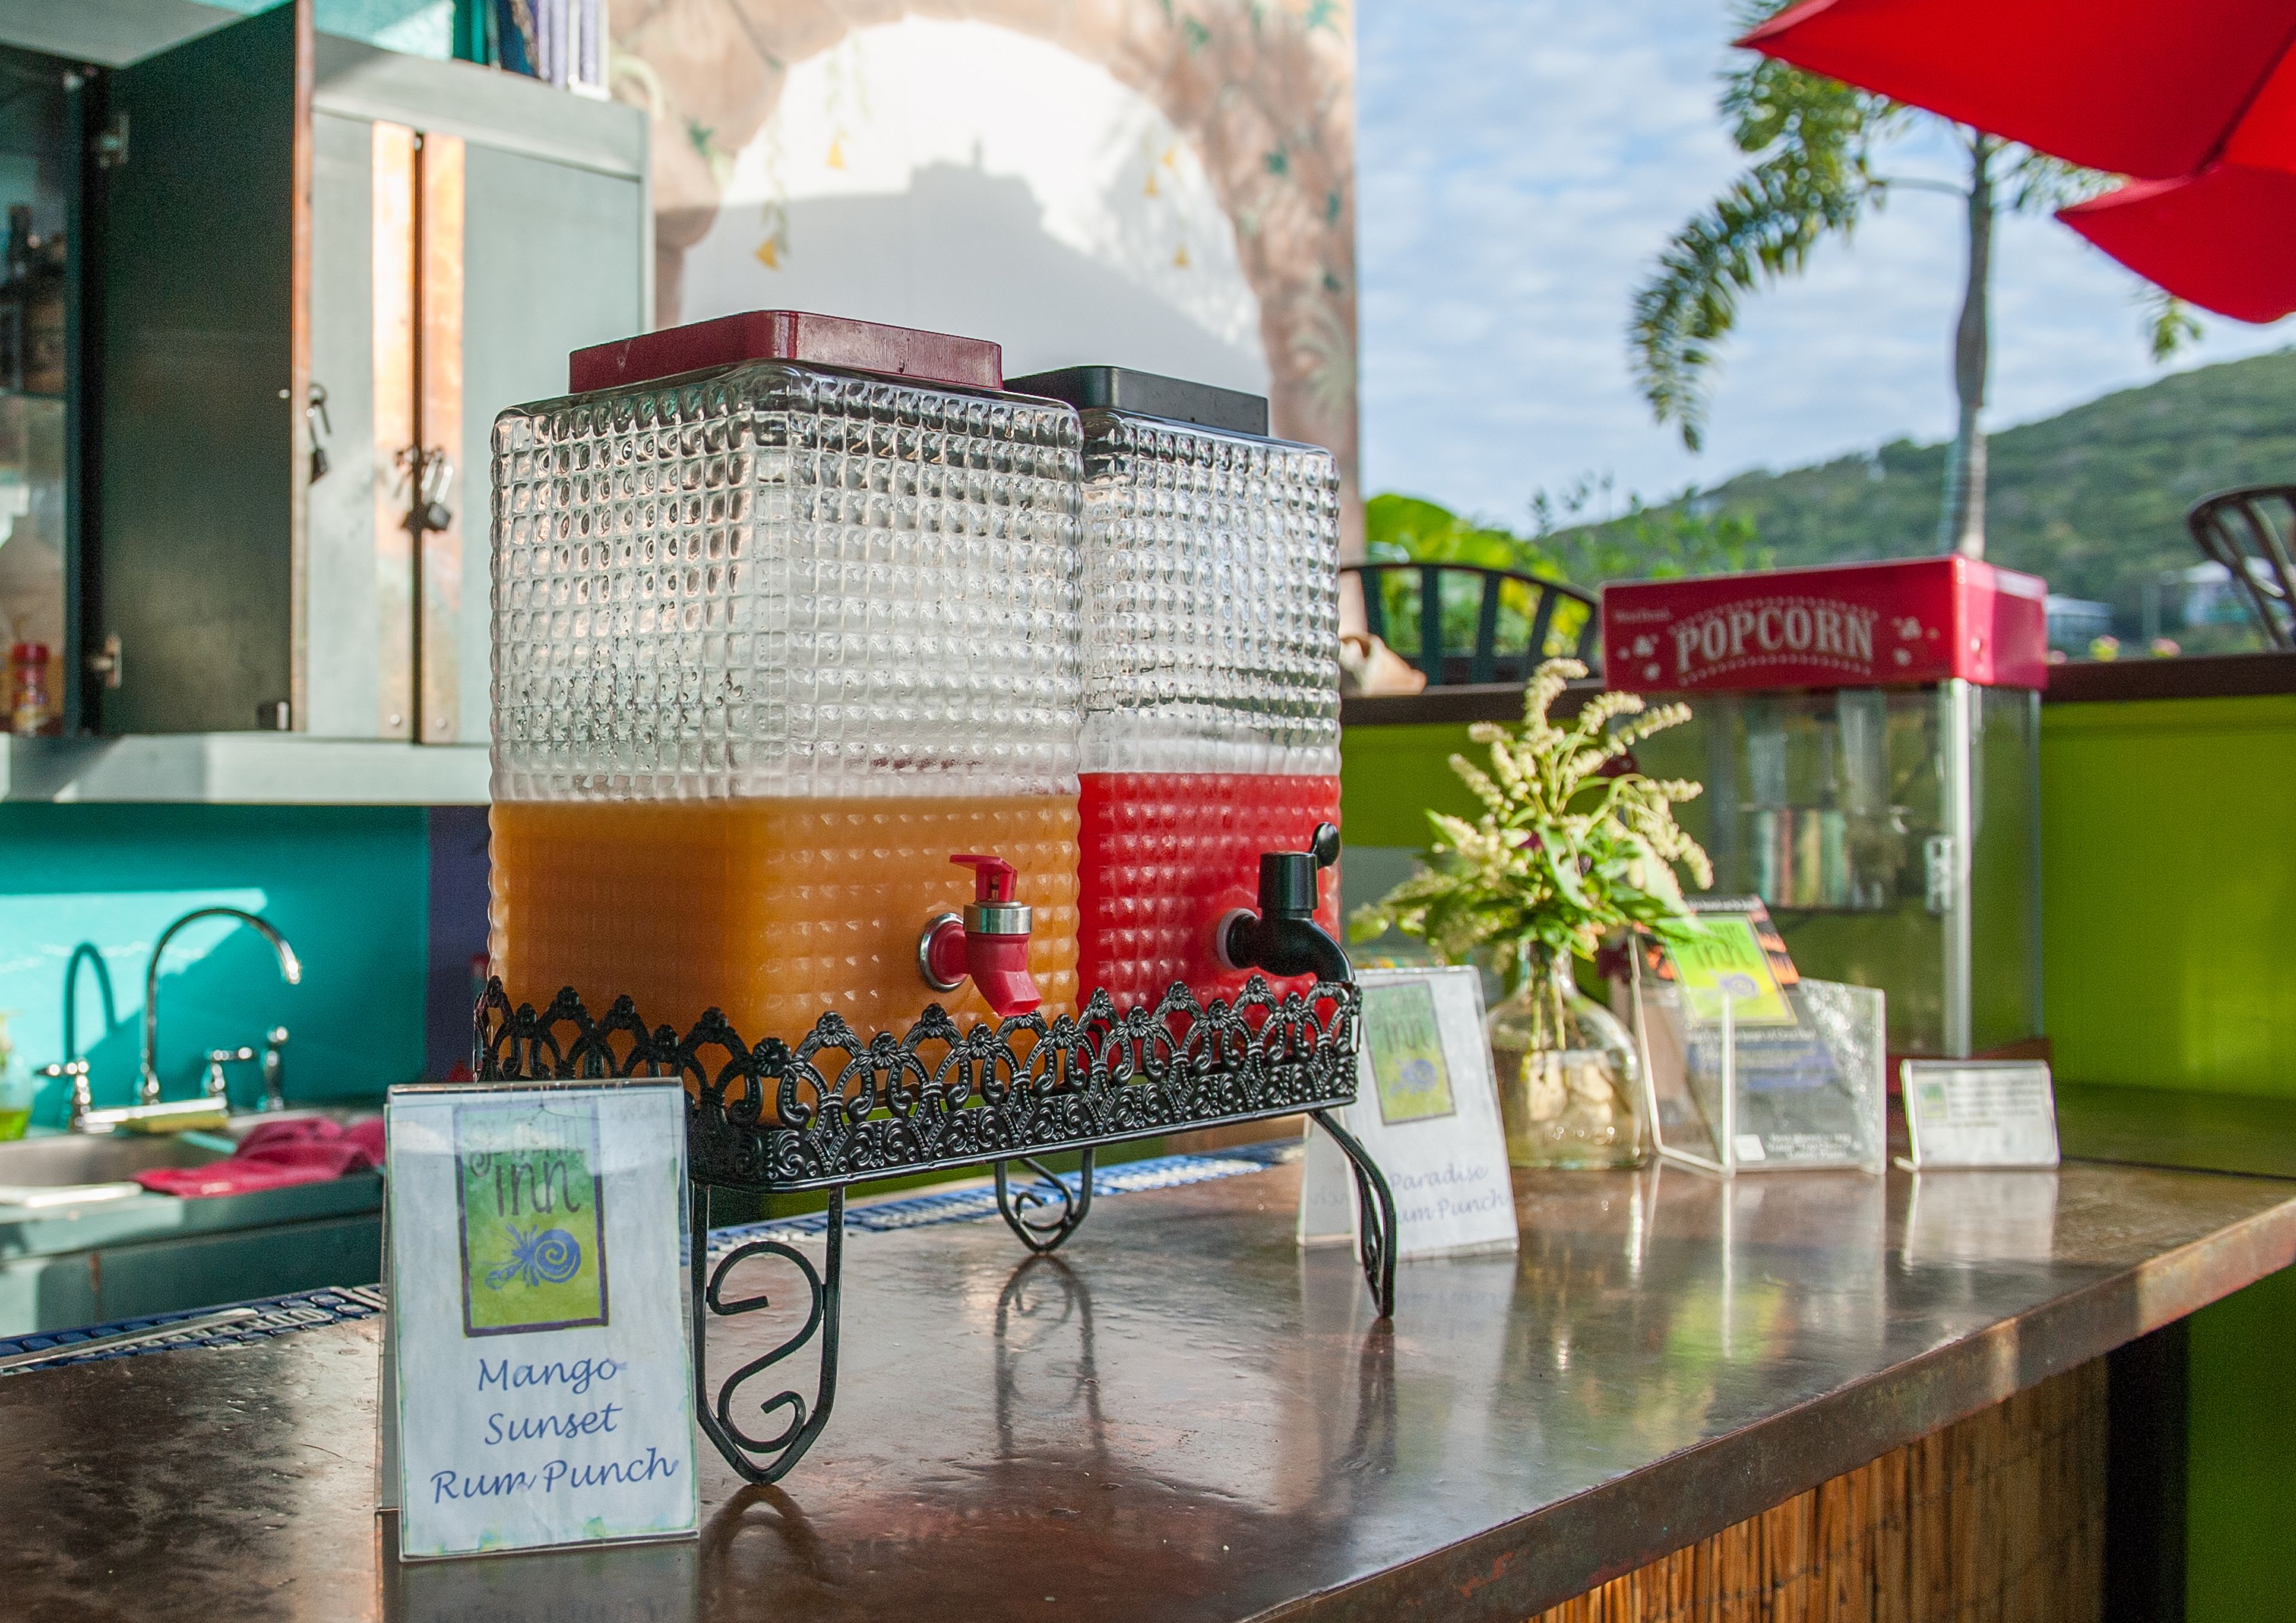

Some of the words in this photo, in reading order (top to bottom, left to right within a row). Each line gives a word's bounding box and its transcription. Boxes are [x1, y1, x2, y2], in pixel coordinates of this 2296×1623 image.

[1677, 606, 1874, 673] POPCORN
[1388, 1162, 1489, 1192] Paradise
[1397, 1205, 1436, 1225] um
[1436, 1188, 1510, 1219] Punch
[478, 1358, 625, 1395] Mango
[484, 1402, 623, 1445] Sunset
[430, 1469, 536, 1505] Rum
[543, 1447, 678, 1494] Punch
